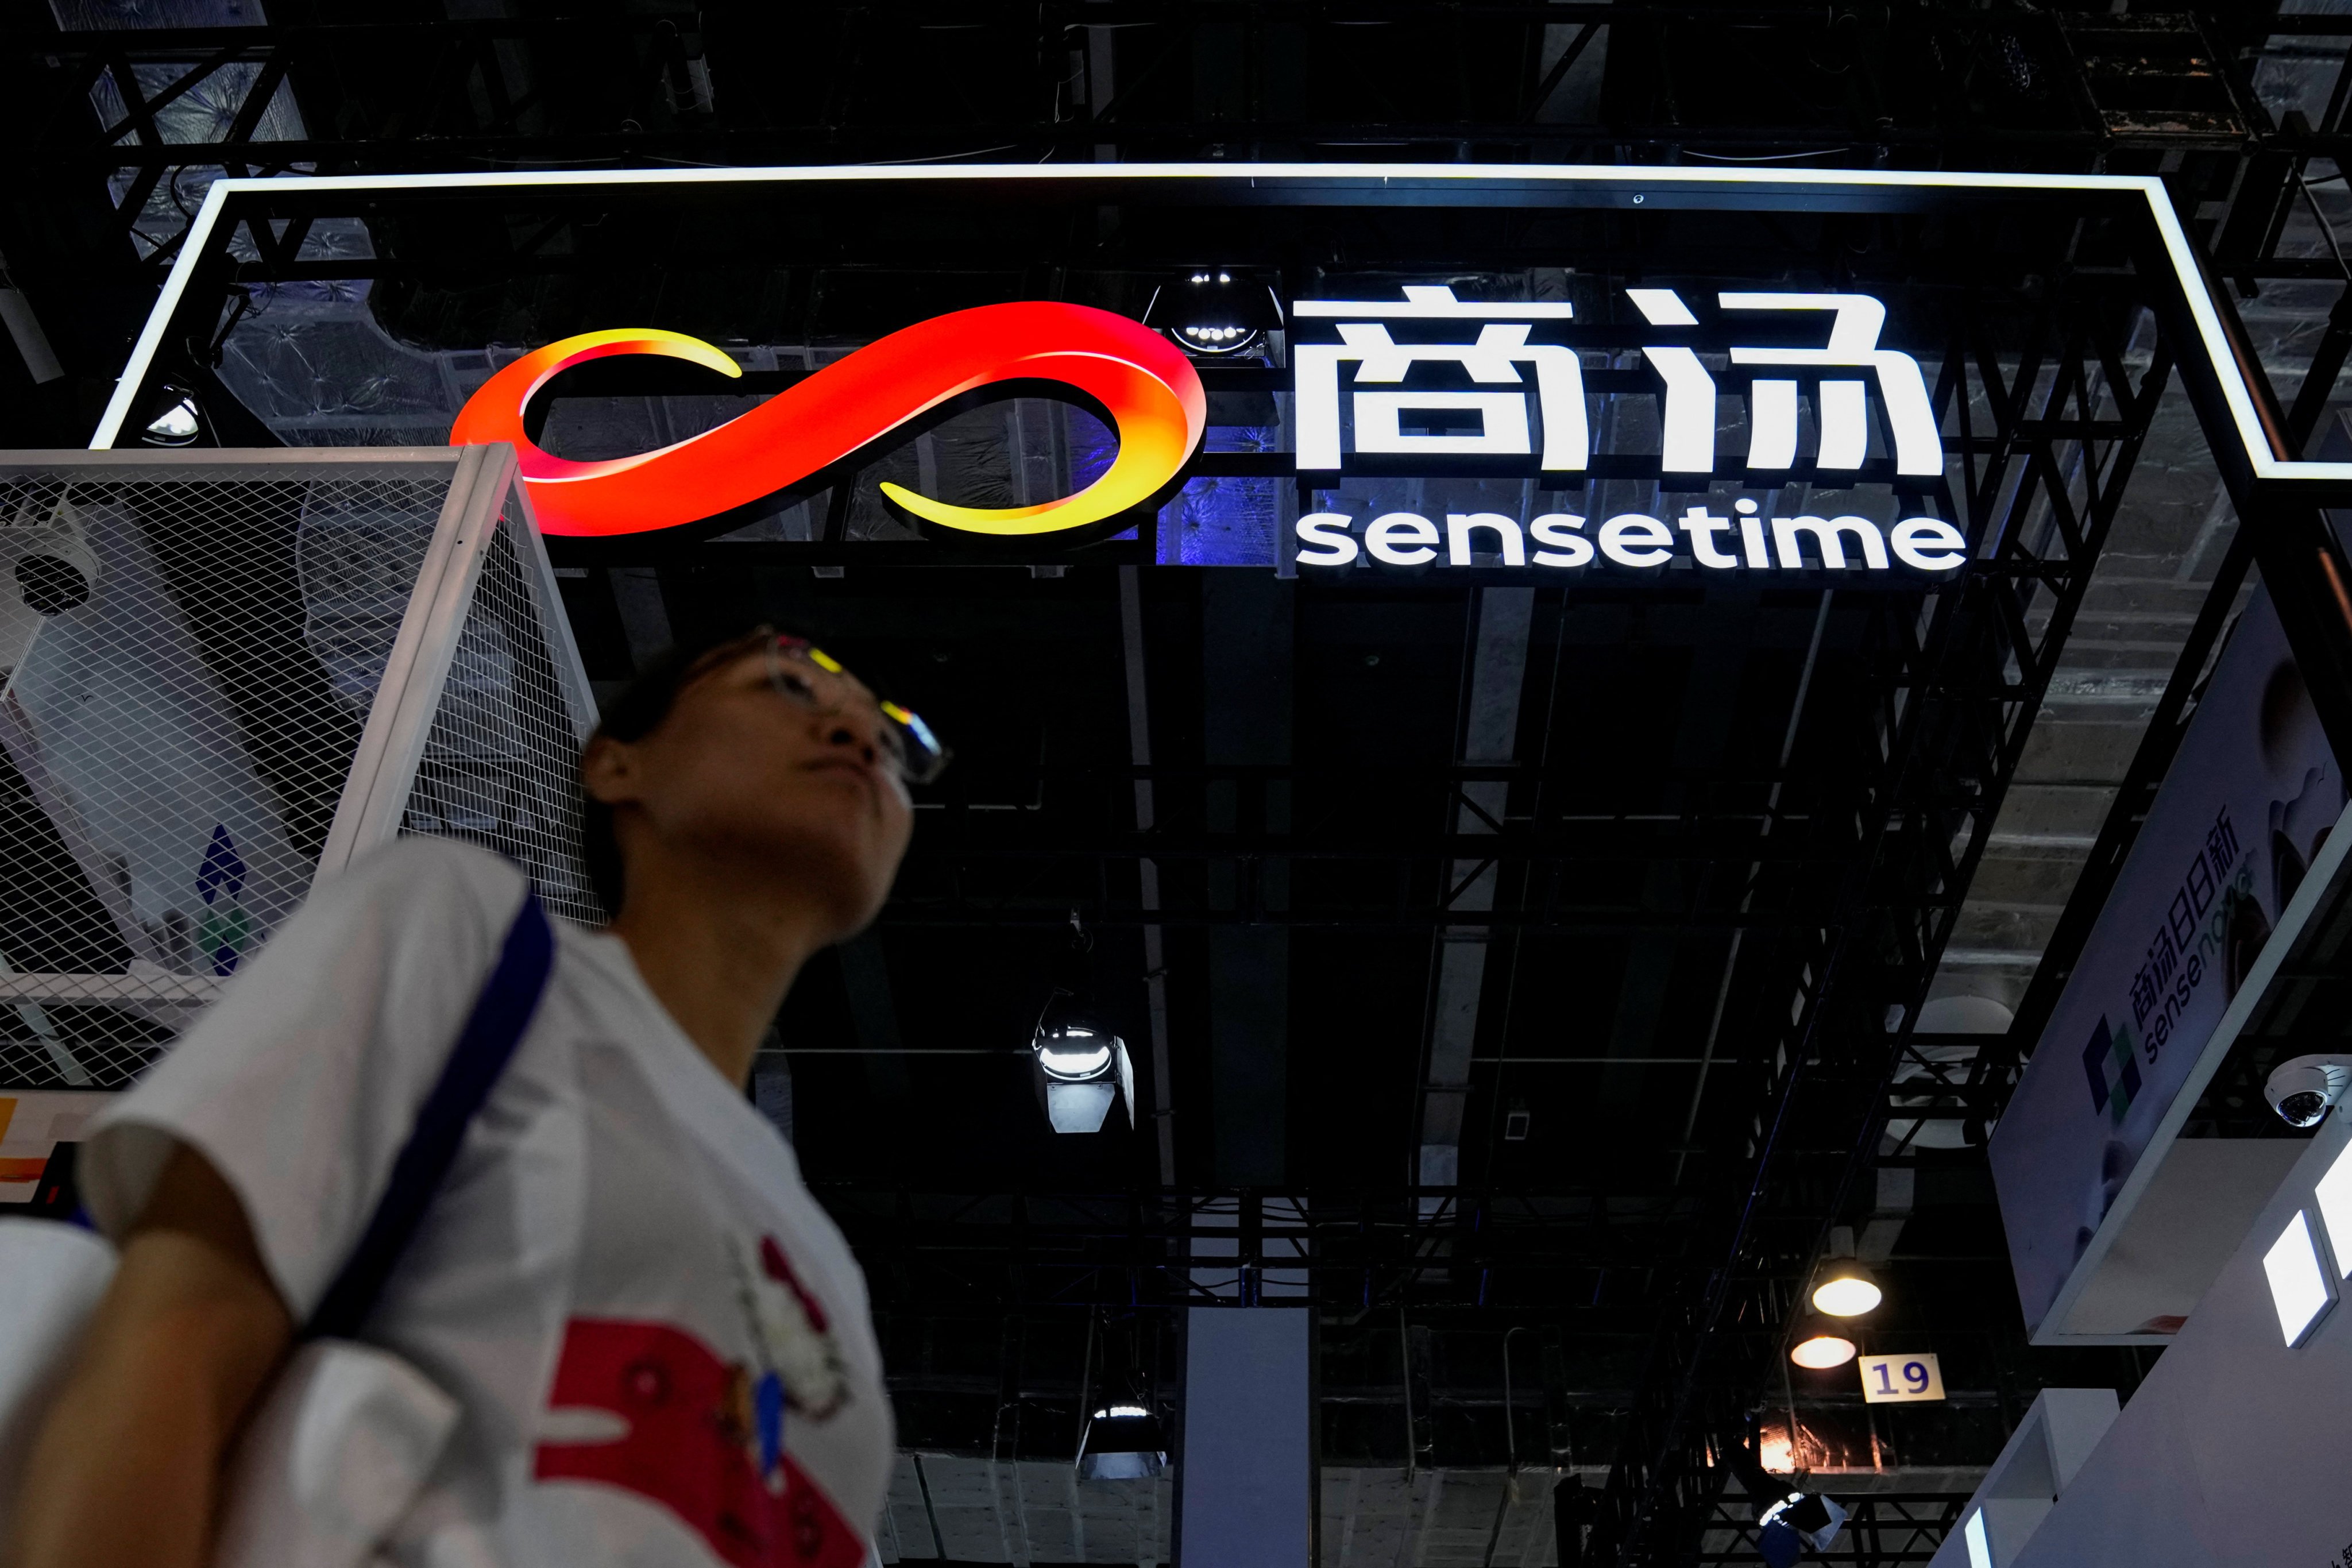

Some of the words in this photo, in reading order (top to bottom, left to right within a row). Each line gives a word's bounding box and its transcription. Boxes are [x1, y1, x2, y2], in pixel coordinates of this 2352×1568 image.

[1296, 499, 1966, 570] sensetime
[2129, 804, 2239, 1032] 商汤日日新
[1872, 1362, 1929, 1395] 19
